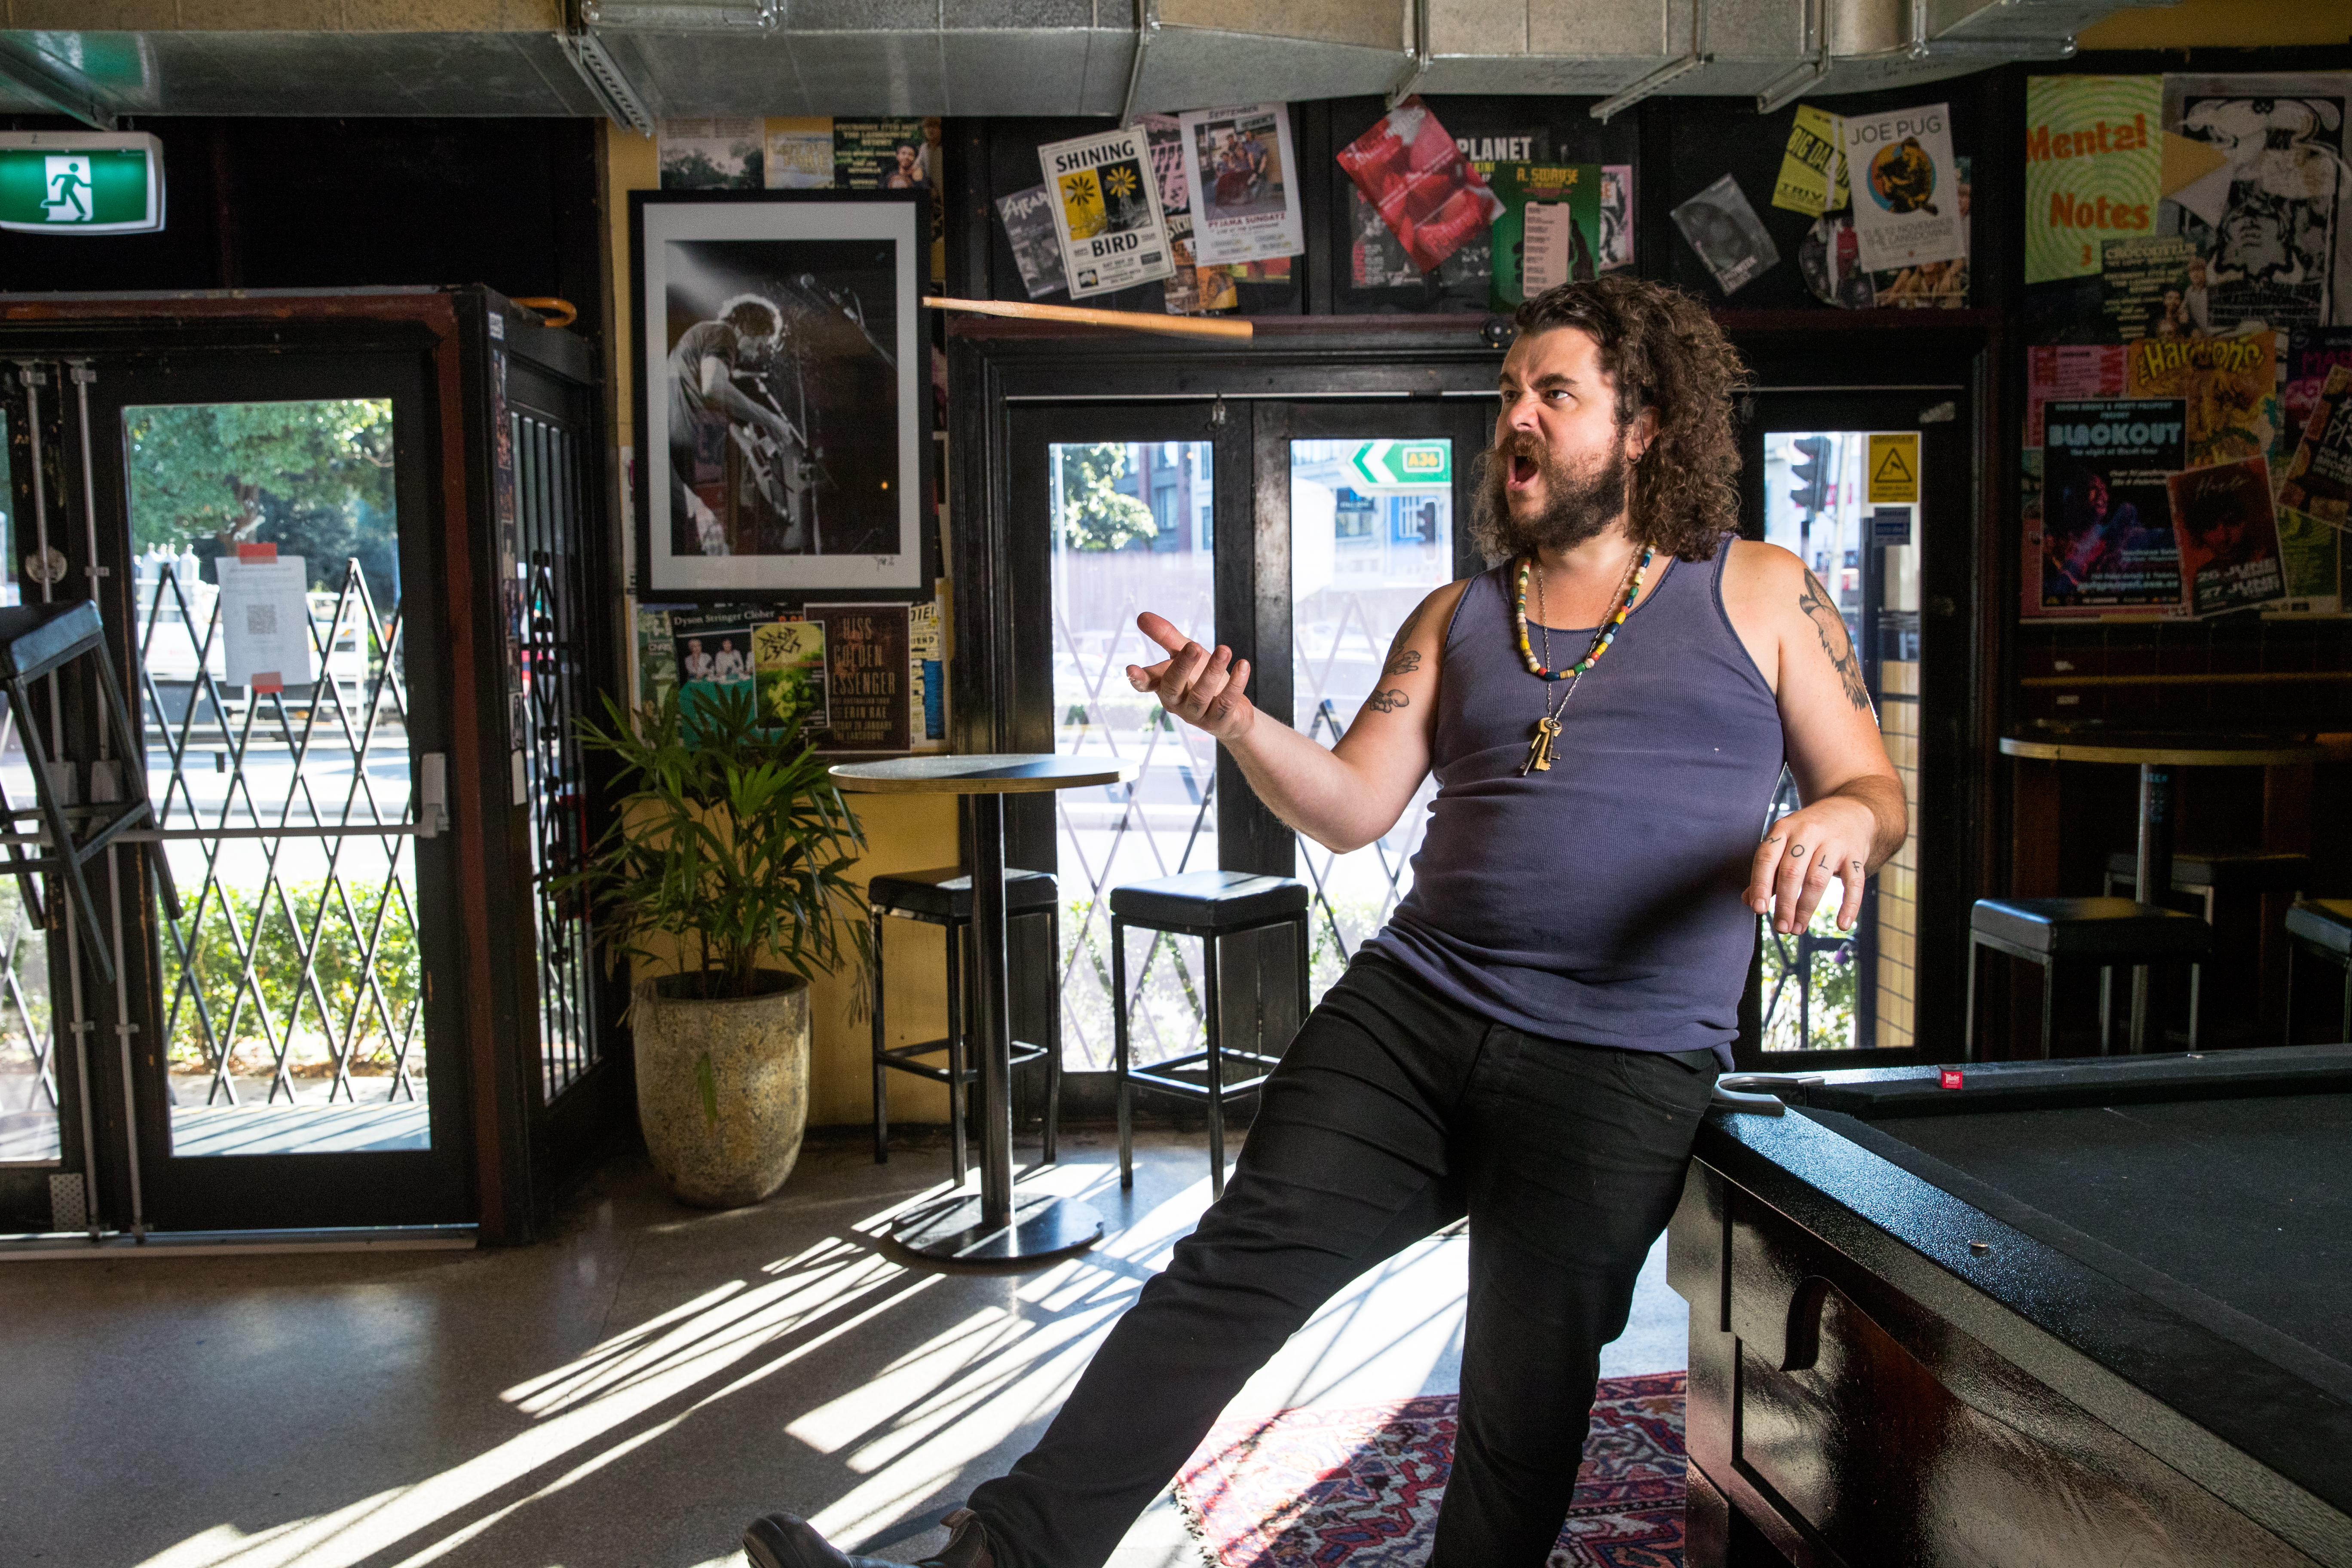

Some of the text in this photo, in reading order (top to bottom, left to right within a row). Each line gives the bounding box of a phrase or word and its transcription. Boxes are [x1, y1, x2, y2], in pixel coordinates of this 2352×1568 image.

[1850, 115, 1941, 145] JOE PUG
[2026, 113, 2147, 162] Mental
[1056, 140, 1135, 172] SHINING
[1456, 136, 1532, 161] PLANET
[1208, 217, 1242, 228] PYJAMA
[2050, 193, 2150, 230] Notes
[1092, 233, 1138, 257] BIRD
[1408, 453, 1438, 466] A36
[674, 609, 775, 628] Dyson Stringer Cloher
[843, 617, 872, 640] HISS
[912, 637, 934, 645] IEND
[833, 644, 882, 668] GOLDEN
[844, 706, 886, 719] ERIN RAE
